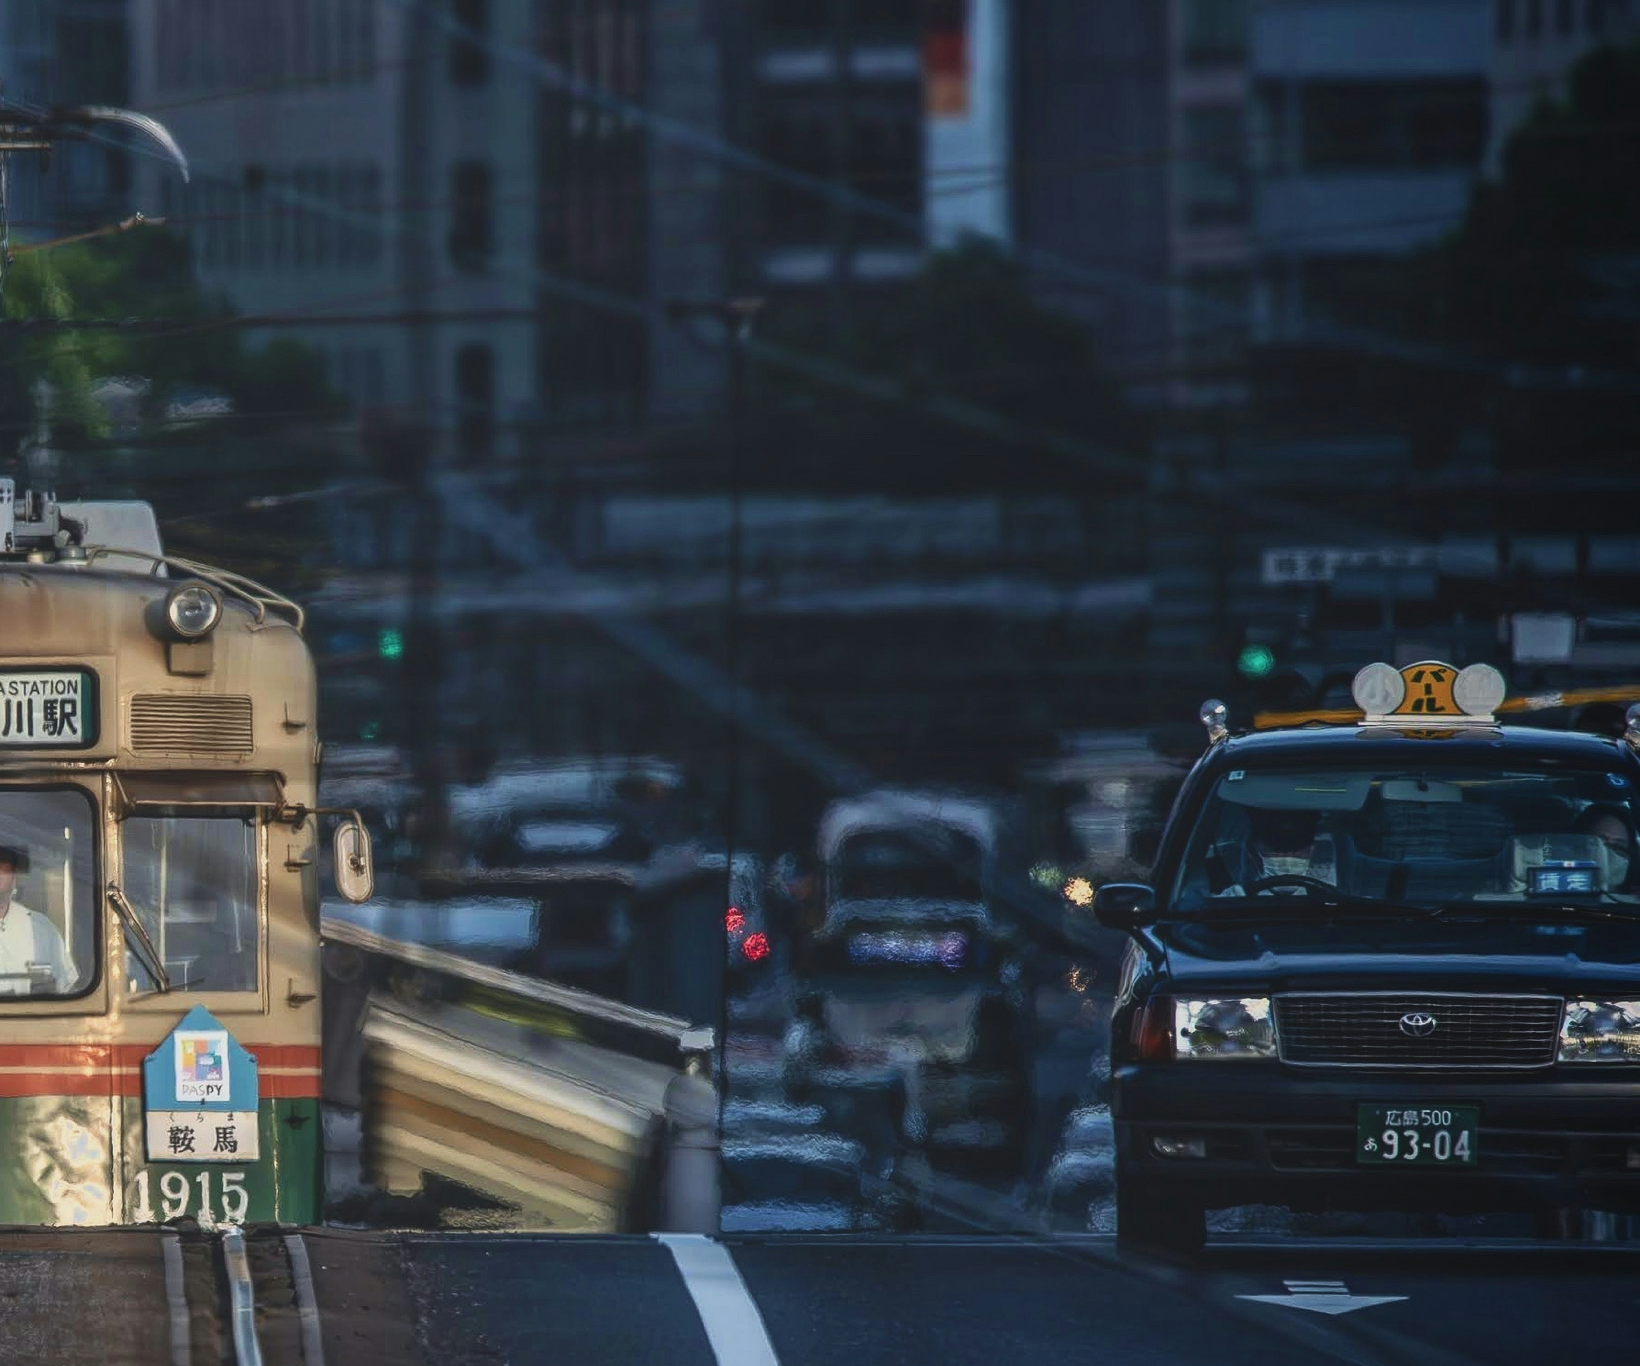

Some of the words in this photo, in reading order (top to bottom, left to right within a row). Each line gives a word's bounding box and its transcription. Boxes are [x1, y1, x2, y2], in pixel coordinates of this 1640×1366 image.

[8, 679, 78, 695] STATION
[1411, 668, 1446, 711] パール
[181, 1084, 223, 1096] PASPY
[167, 1125, 239, 1154] 鞍馬
[1382, 1129, 1471, 1162] 93-04
[134, 1169, 249, 1225] 1915
